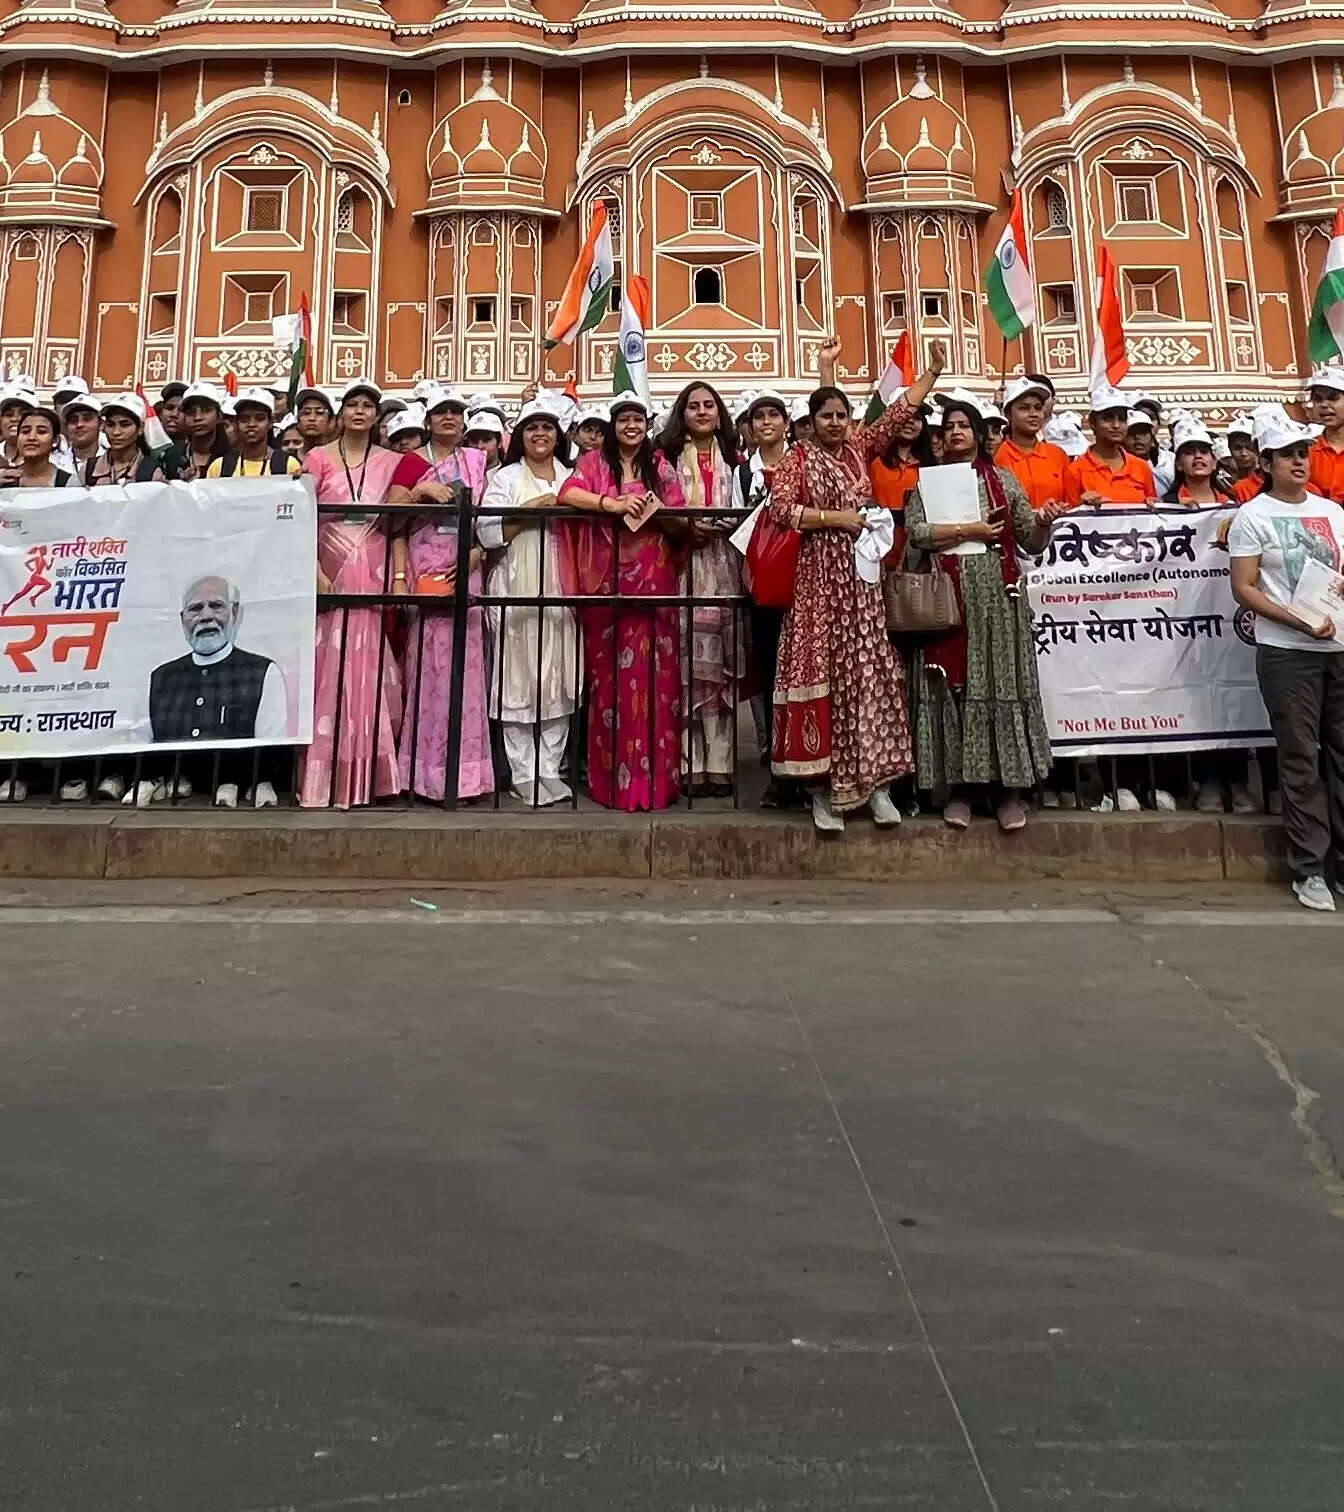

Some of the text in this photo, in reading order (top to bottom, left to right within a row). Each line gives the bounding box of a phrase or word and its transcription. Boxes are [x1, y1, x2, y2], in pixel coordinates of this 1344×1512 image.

[52, 535, 128, 559] नारी शक्ति
[74, 557, 127, 577] विकसित
[54, 578, 126, 610] भारत
[1067, 593, 1081, 605] by
[1083, 609, 1136, 644] सेवा
[1141, 607, 1225, 641] योजना
[37, 710, 118, 733] राजस्थान
[1120, 715, 1148, 731] But
